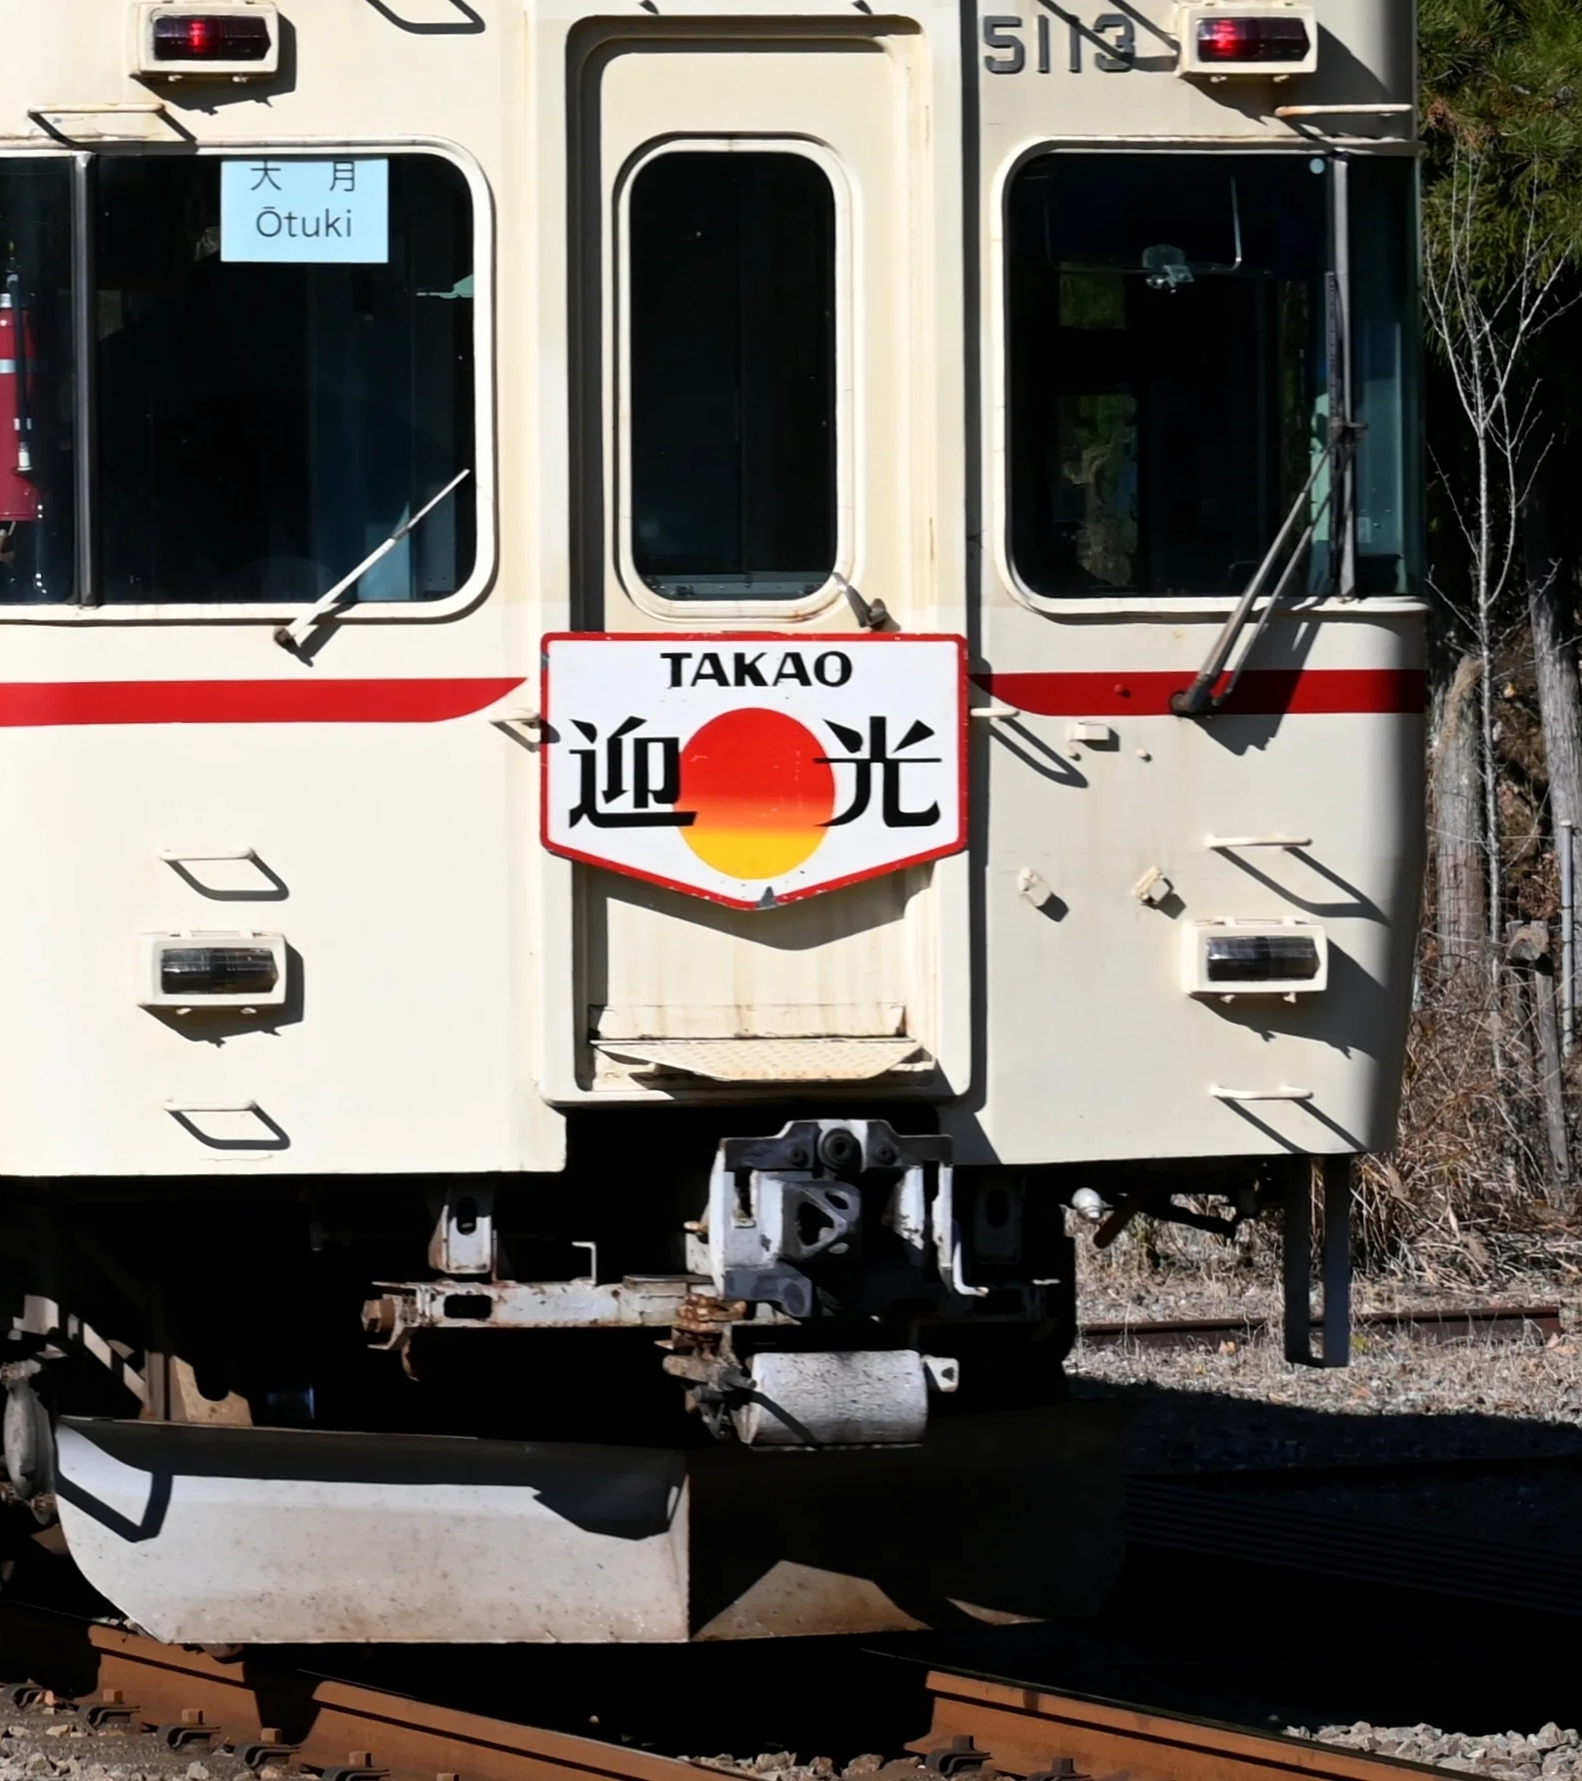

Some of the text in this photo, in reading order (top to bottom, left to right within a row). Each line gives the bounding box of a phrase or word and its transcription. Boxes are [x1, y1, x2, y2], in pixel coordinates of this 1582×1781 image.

[983, 13, 1135, 74] 5113
[250, 160, 355, 192] 大月
[256, 206, 352, 238] Ōtuki
[660, 650, 853, 690] TAKAO
[568, 715, 942, 829] 迎光
